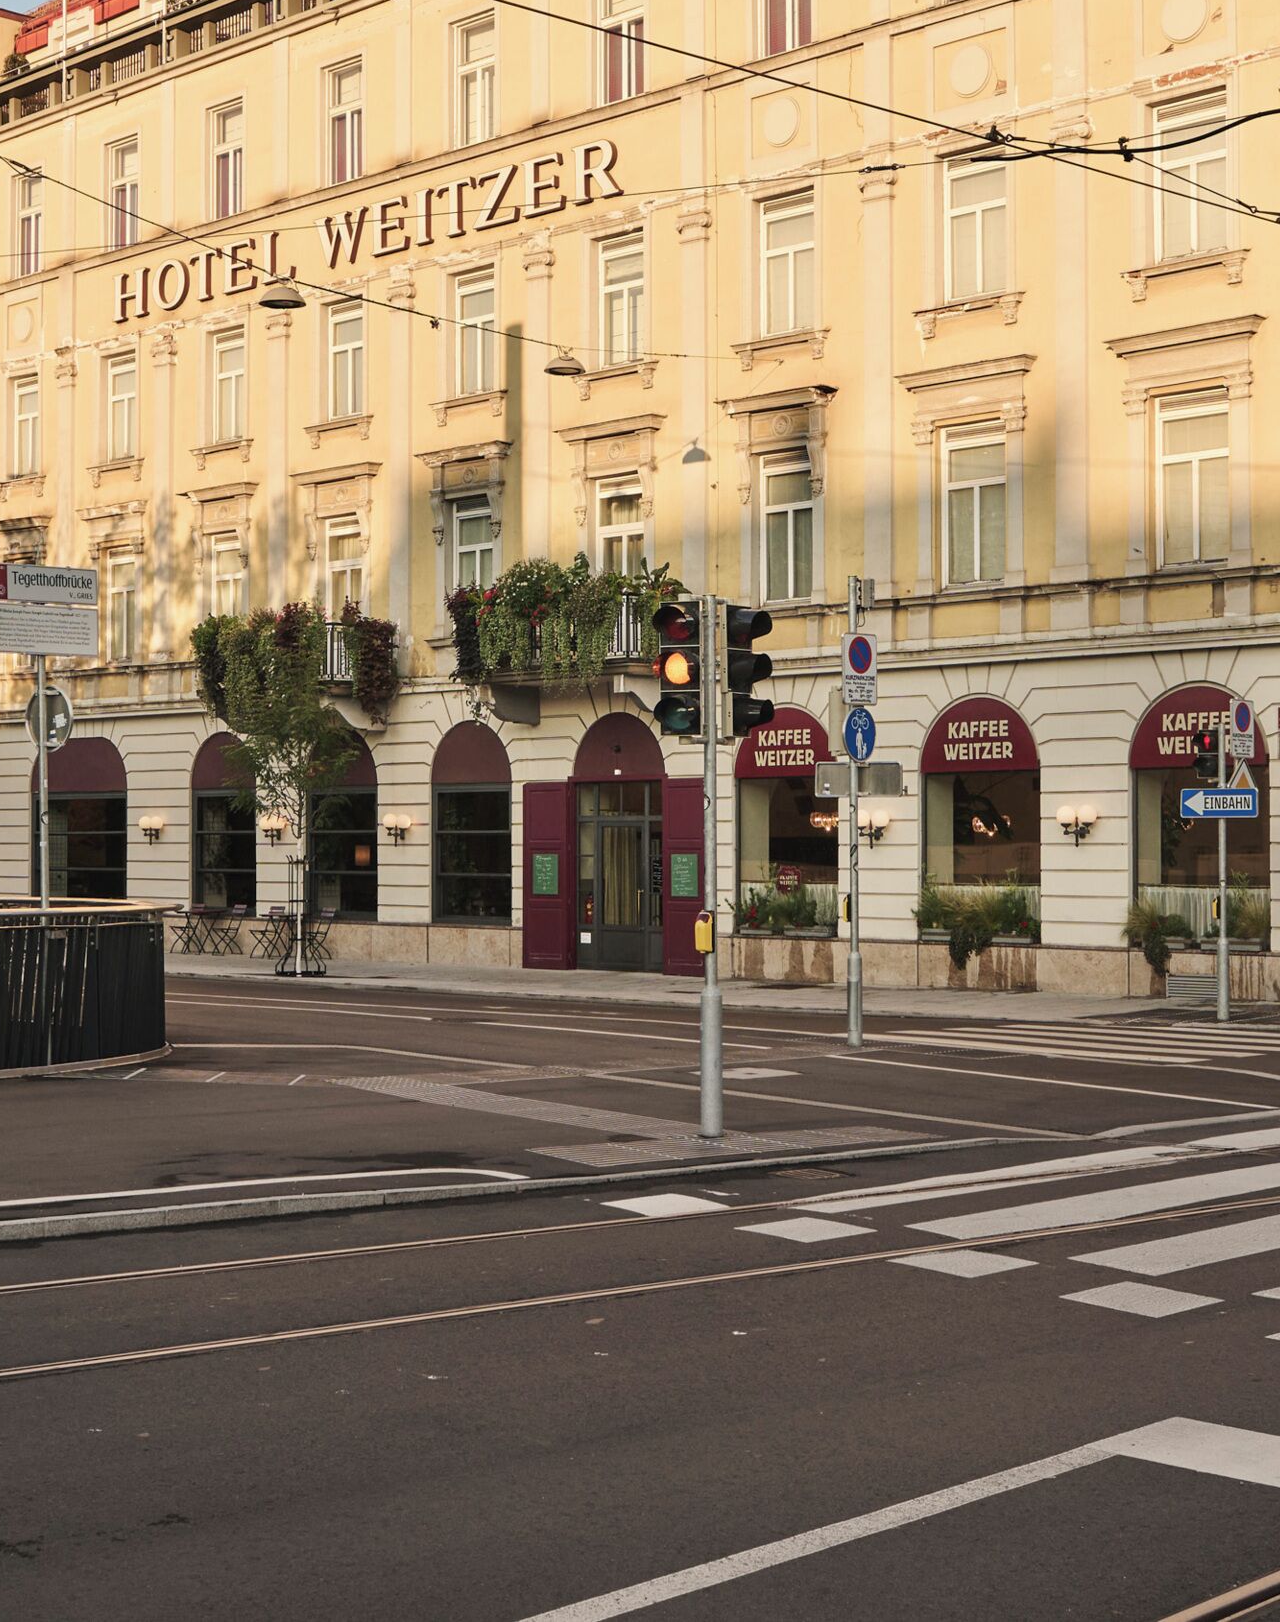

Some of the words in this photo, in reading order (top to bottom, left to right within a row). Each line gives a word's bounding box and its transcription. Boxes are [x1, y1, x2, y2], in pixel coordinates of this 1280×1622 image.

[112, 232, 296, 323] HOTEL
[314, 139, 624, 269] WEITZER
[11, 570, 93, 590] Tegetthoffbrücke
[77, 592, 93, 600] GRIES
[948, 719, 1009, 739] KAFFEE
[1162, 711, 1230, 732] KAFFEE
[758, 729, 811, 747] KAFFEE
[754, 749, 815, 767] WEITZER
[943, 741, 1013, 761] WEITZER
[1204, 795, 1251, 810] EINBAHN
